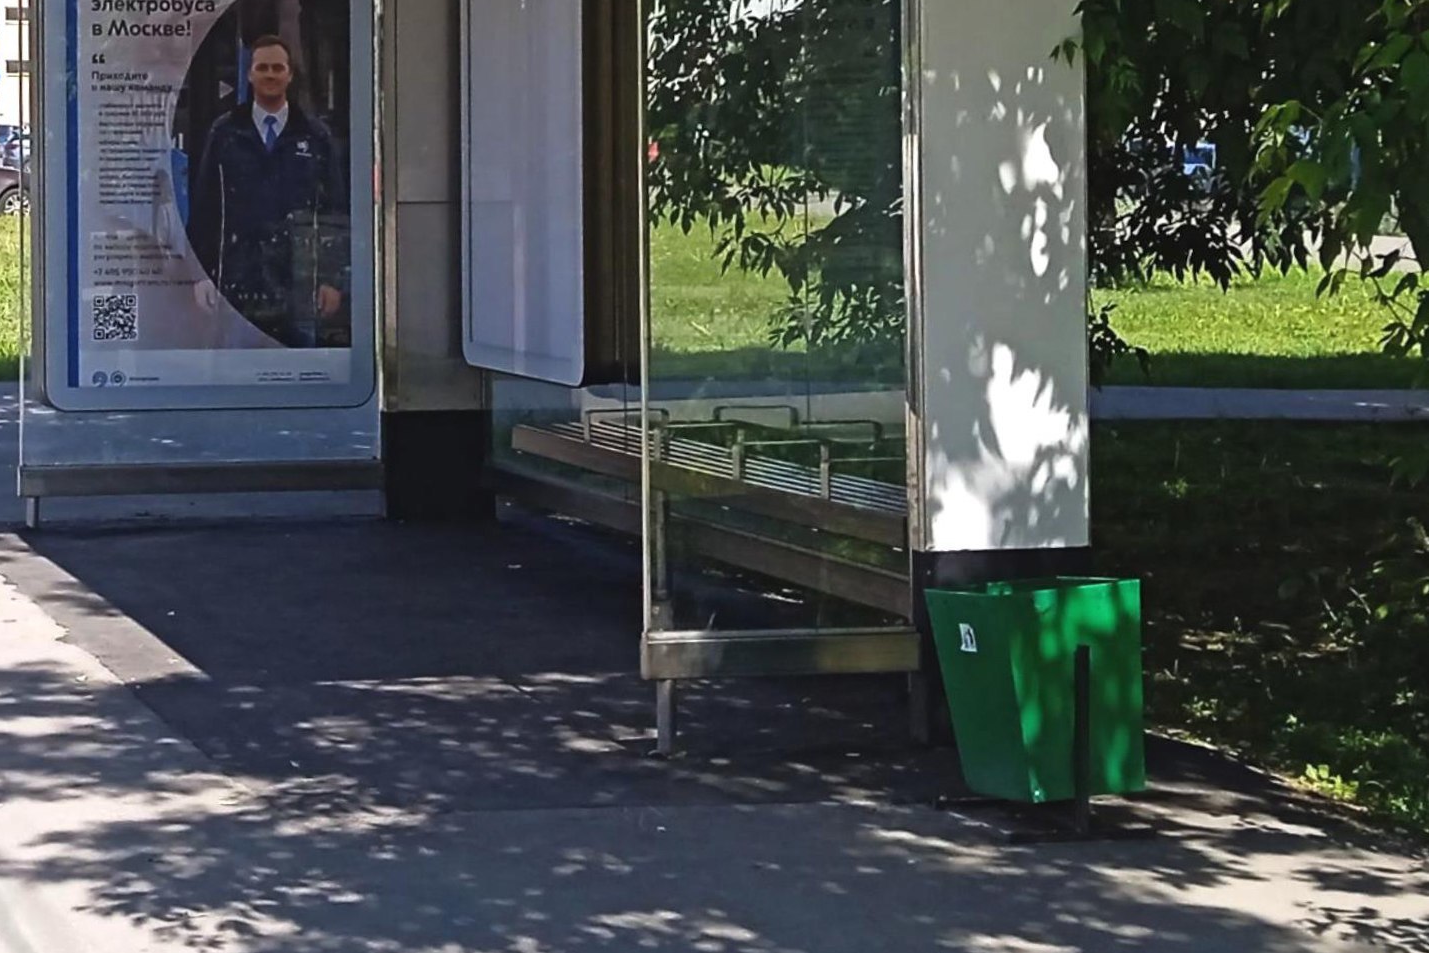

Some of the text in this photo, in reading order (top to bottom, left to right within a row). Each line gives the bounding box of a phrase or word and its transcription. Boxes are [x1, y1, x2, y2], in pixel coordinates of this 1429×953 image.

[92, 19, 192, 36] в Москве!
[91, 70, 149, 82] Приходите
